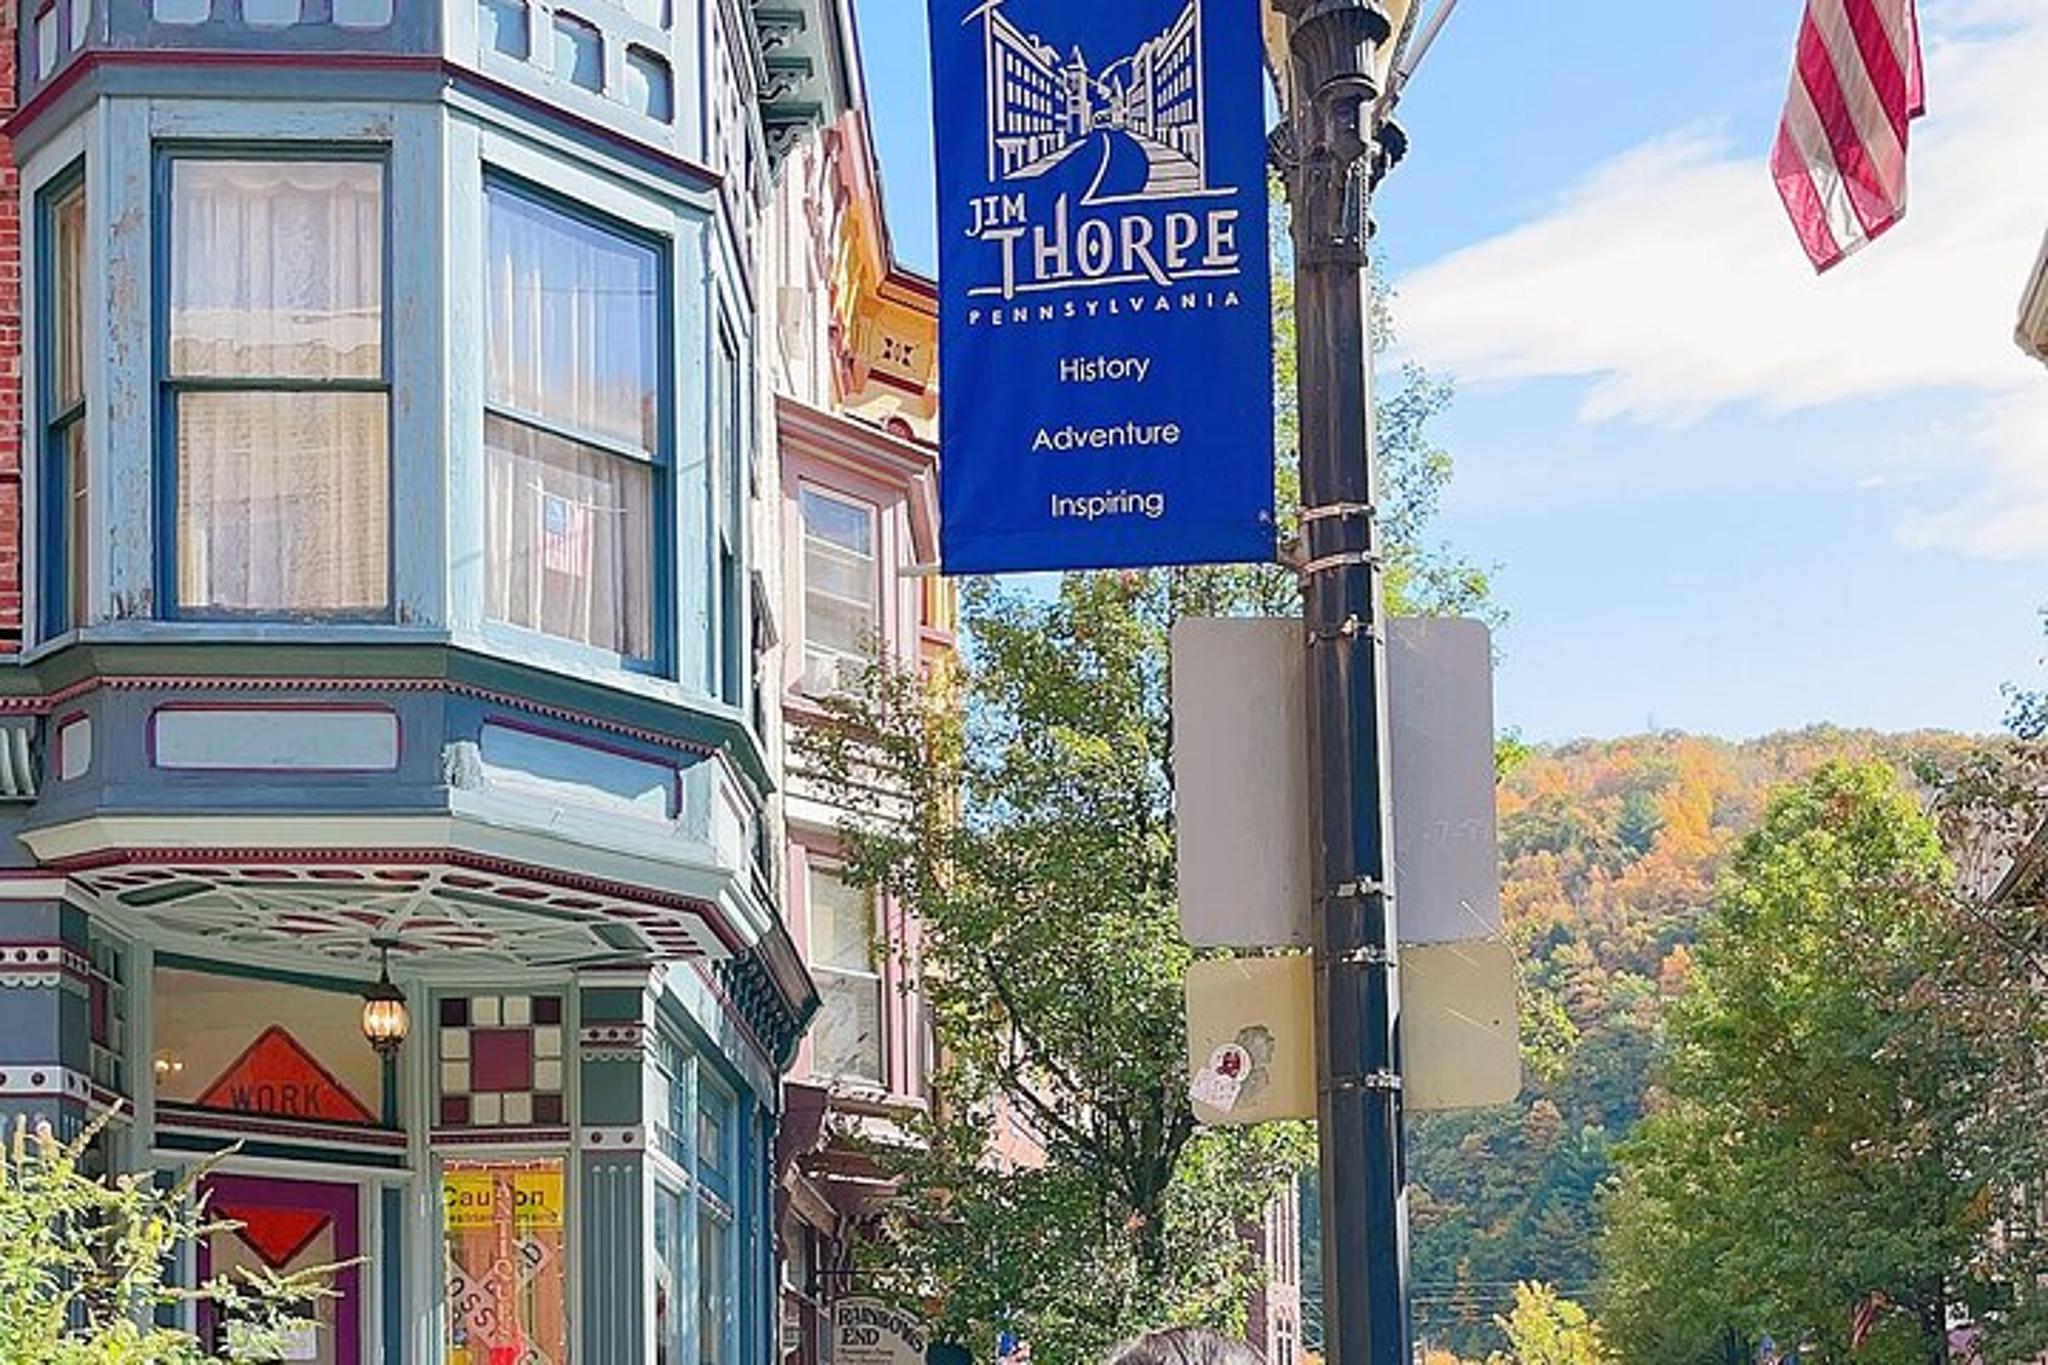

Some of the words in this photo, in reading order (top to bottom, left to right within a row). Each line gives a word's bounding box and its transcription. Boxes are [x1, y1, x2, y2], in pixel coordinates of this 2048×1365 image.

[965, 193, 1028, 237] JIM
[981, 192, 1239, 300] THORPE
[968, 291, 1240, 326] PENNSYLVANIA
[1060, 357, 1151, 382] History
[1032, 420, 1180, 451] Adventure
[1051, 490, 1165, 521] Inspiring
[230, 1082, 321, 1115] WORK
[443, 1185, 545, 1207] Cauon
[841, 1327, 880, 1345] END
